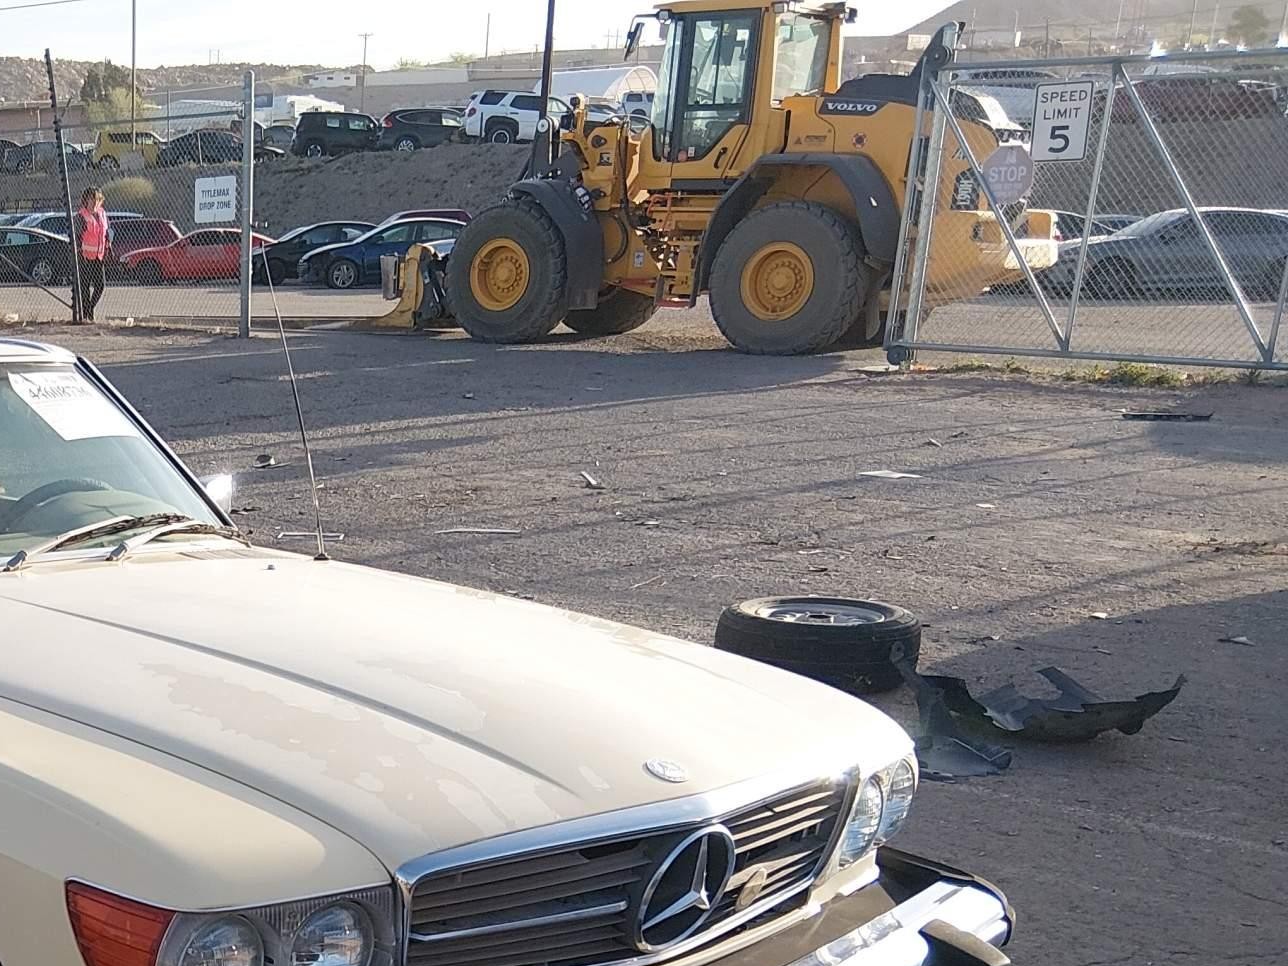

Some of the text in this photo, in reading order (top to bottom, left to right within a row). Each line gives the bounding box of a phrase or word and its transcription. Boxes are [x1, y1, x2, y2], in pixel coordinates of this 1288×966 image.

[1040, 89, 1088, 103] SPEED
[826, 102, 877, 112] VOLVO
[1043, 107, 1081, 121] LIMIT
[1047, 125, 1070, 153] 5
[988, 166, 1027, 182] STOP
[201, 187, 230, 199] TITLEMAX
[199, 200, 231, 211] DROP ZONE
